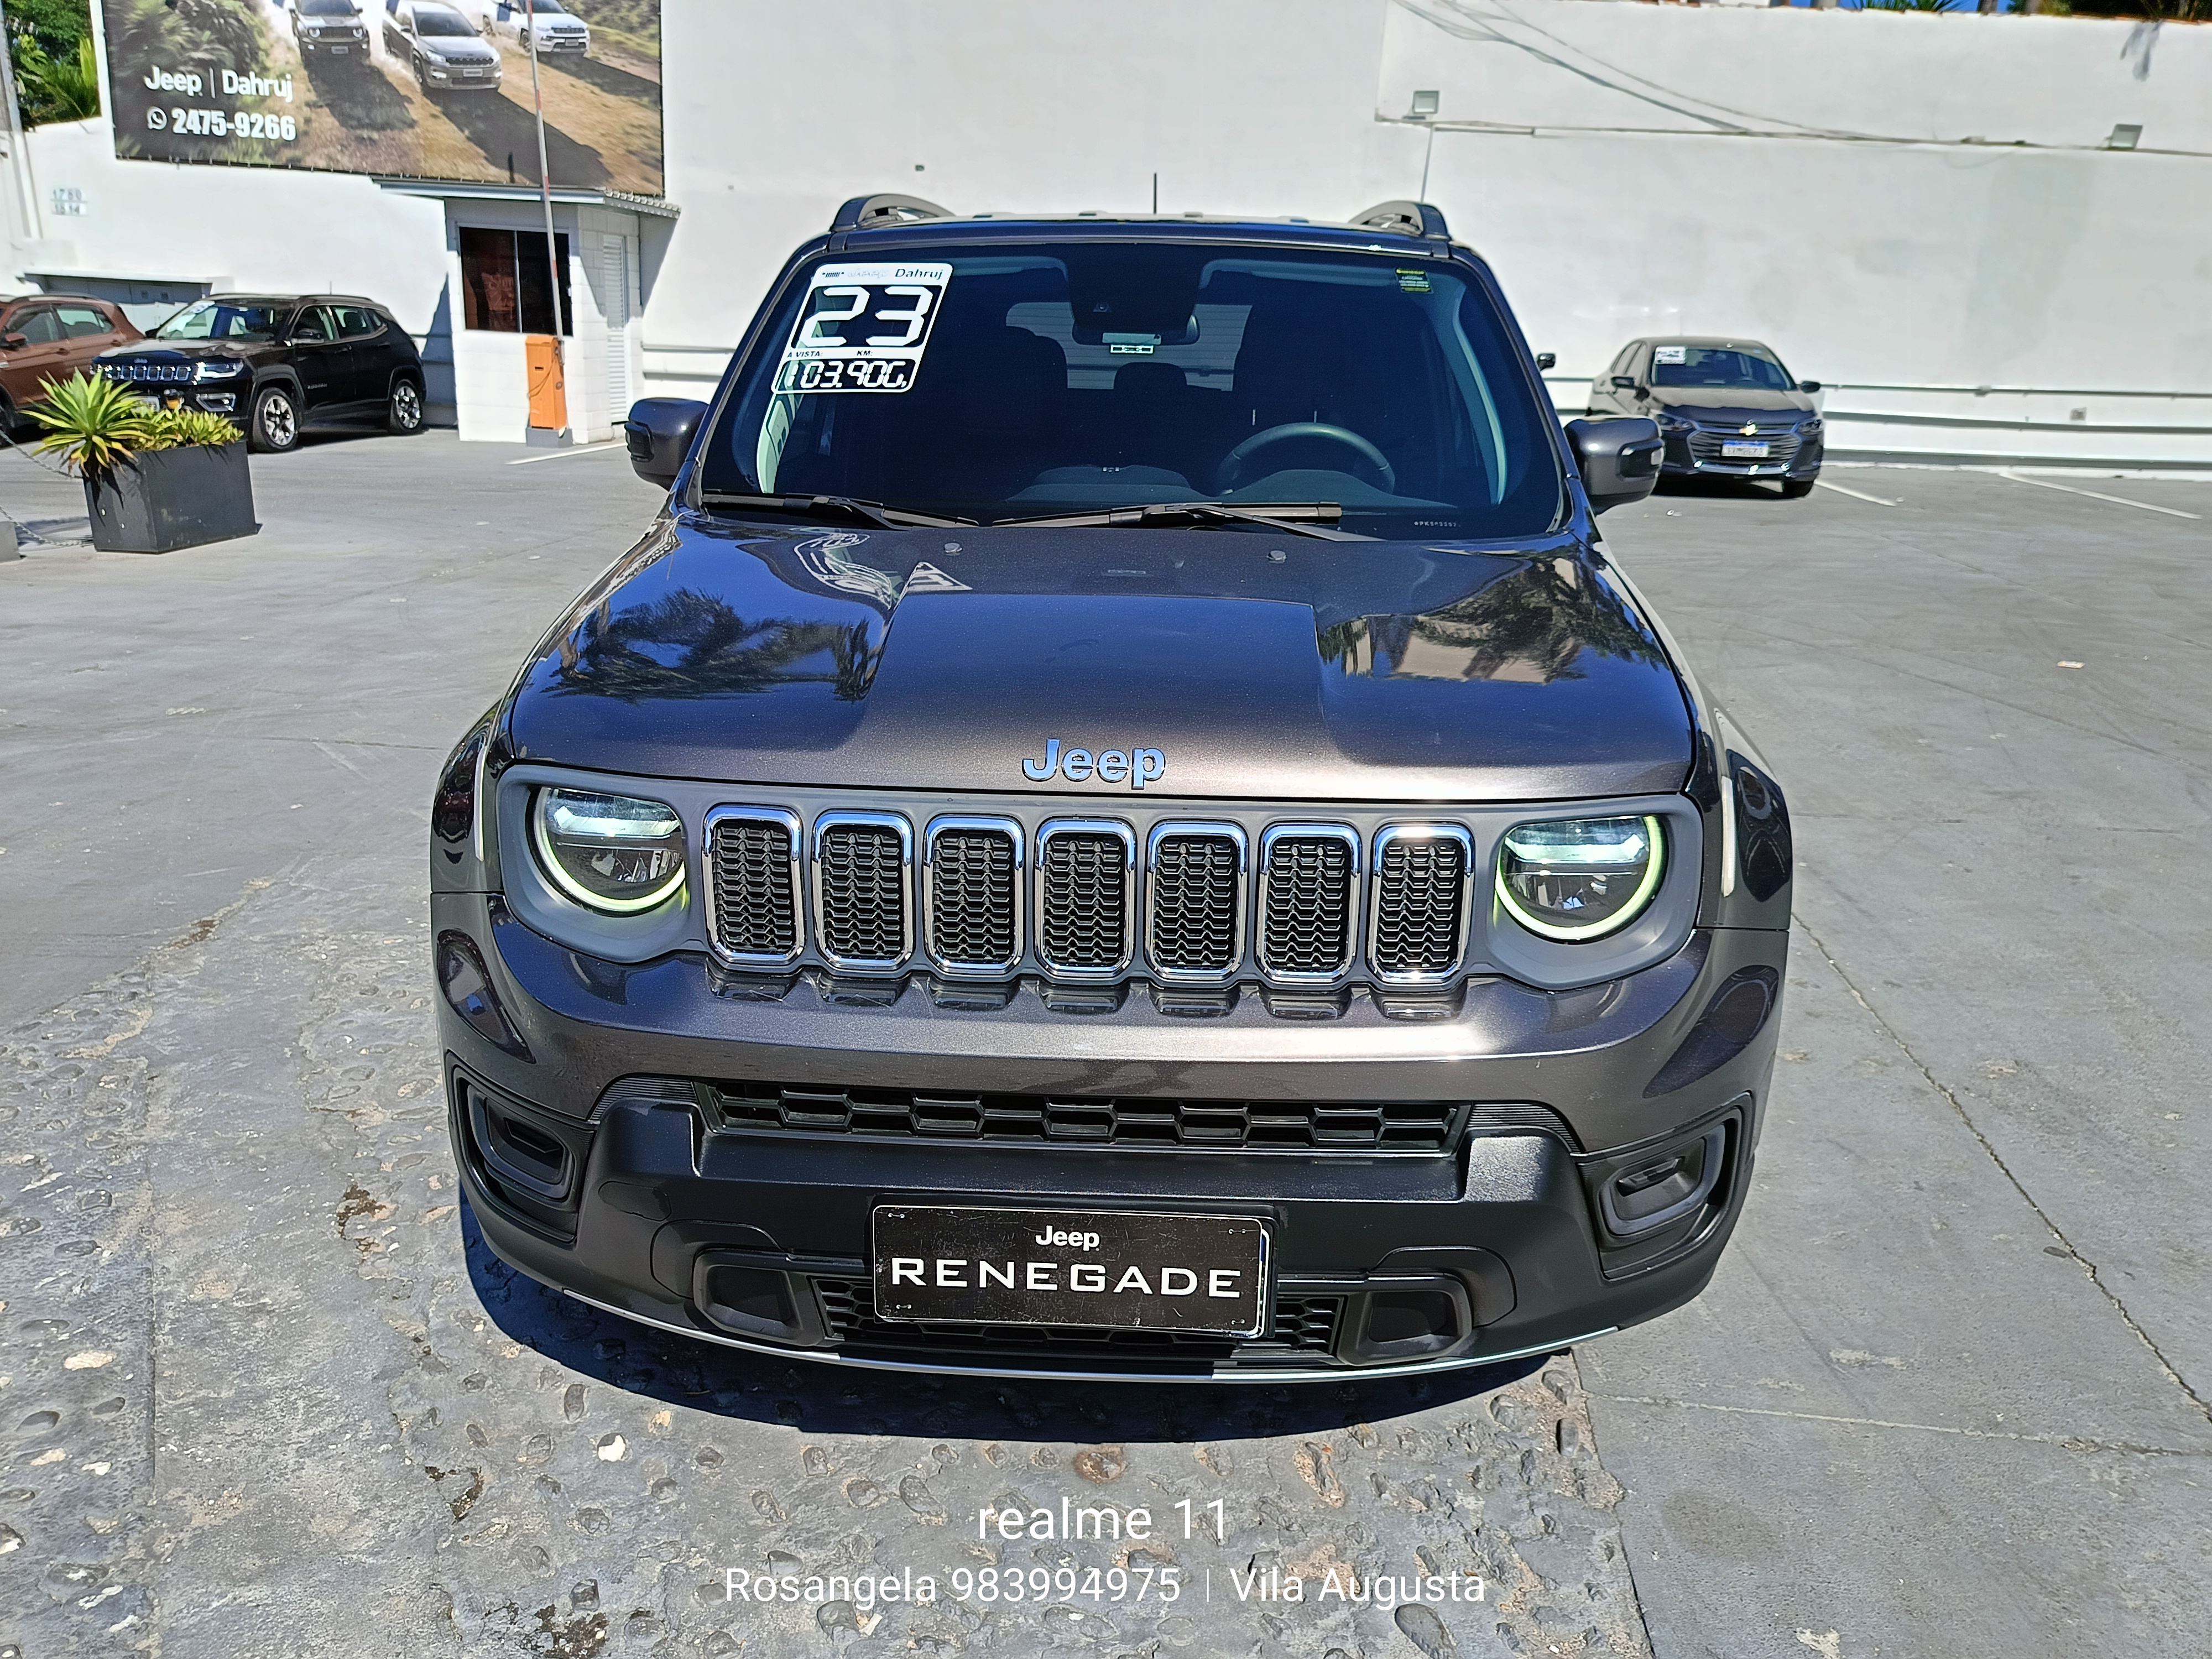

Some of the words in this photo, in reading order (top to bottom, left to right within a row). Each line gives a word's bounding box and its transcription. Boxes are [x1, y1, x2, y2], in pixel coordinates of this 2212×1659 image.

[144, 65, 203, 97] Jeep
[221, 69, 293, 103] Dahruj
[171, 107, 297, 142] 2475-9266
[895, 269, 943, 280] Dahruj
[799, 285, 933, 347] 23
[1022, 738, 1166, 790] Jeep
[1035, 1225, 1100, 1251] Jeep
[891, 1257, 1242, 1298] RENEGADE
